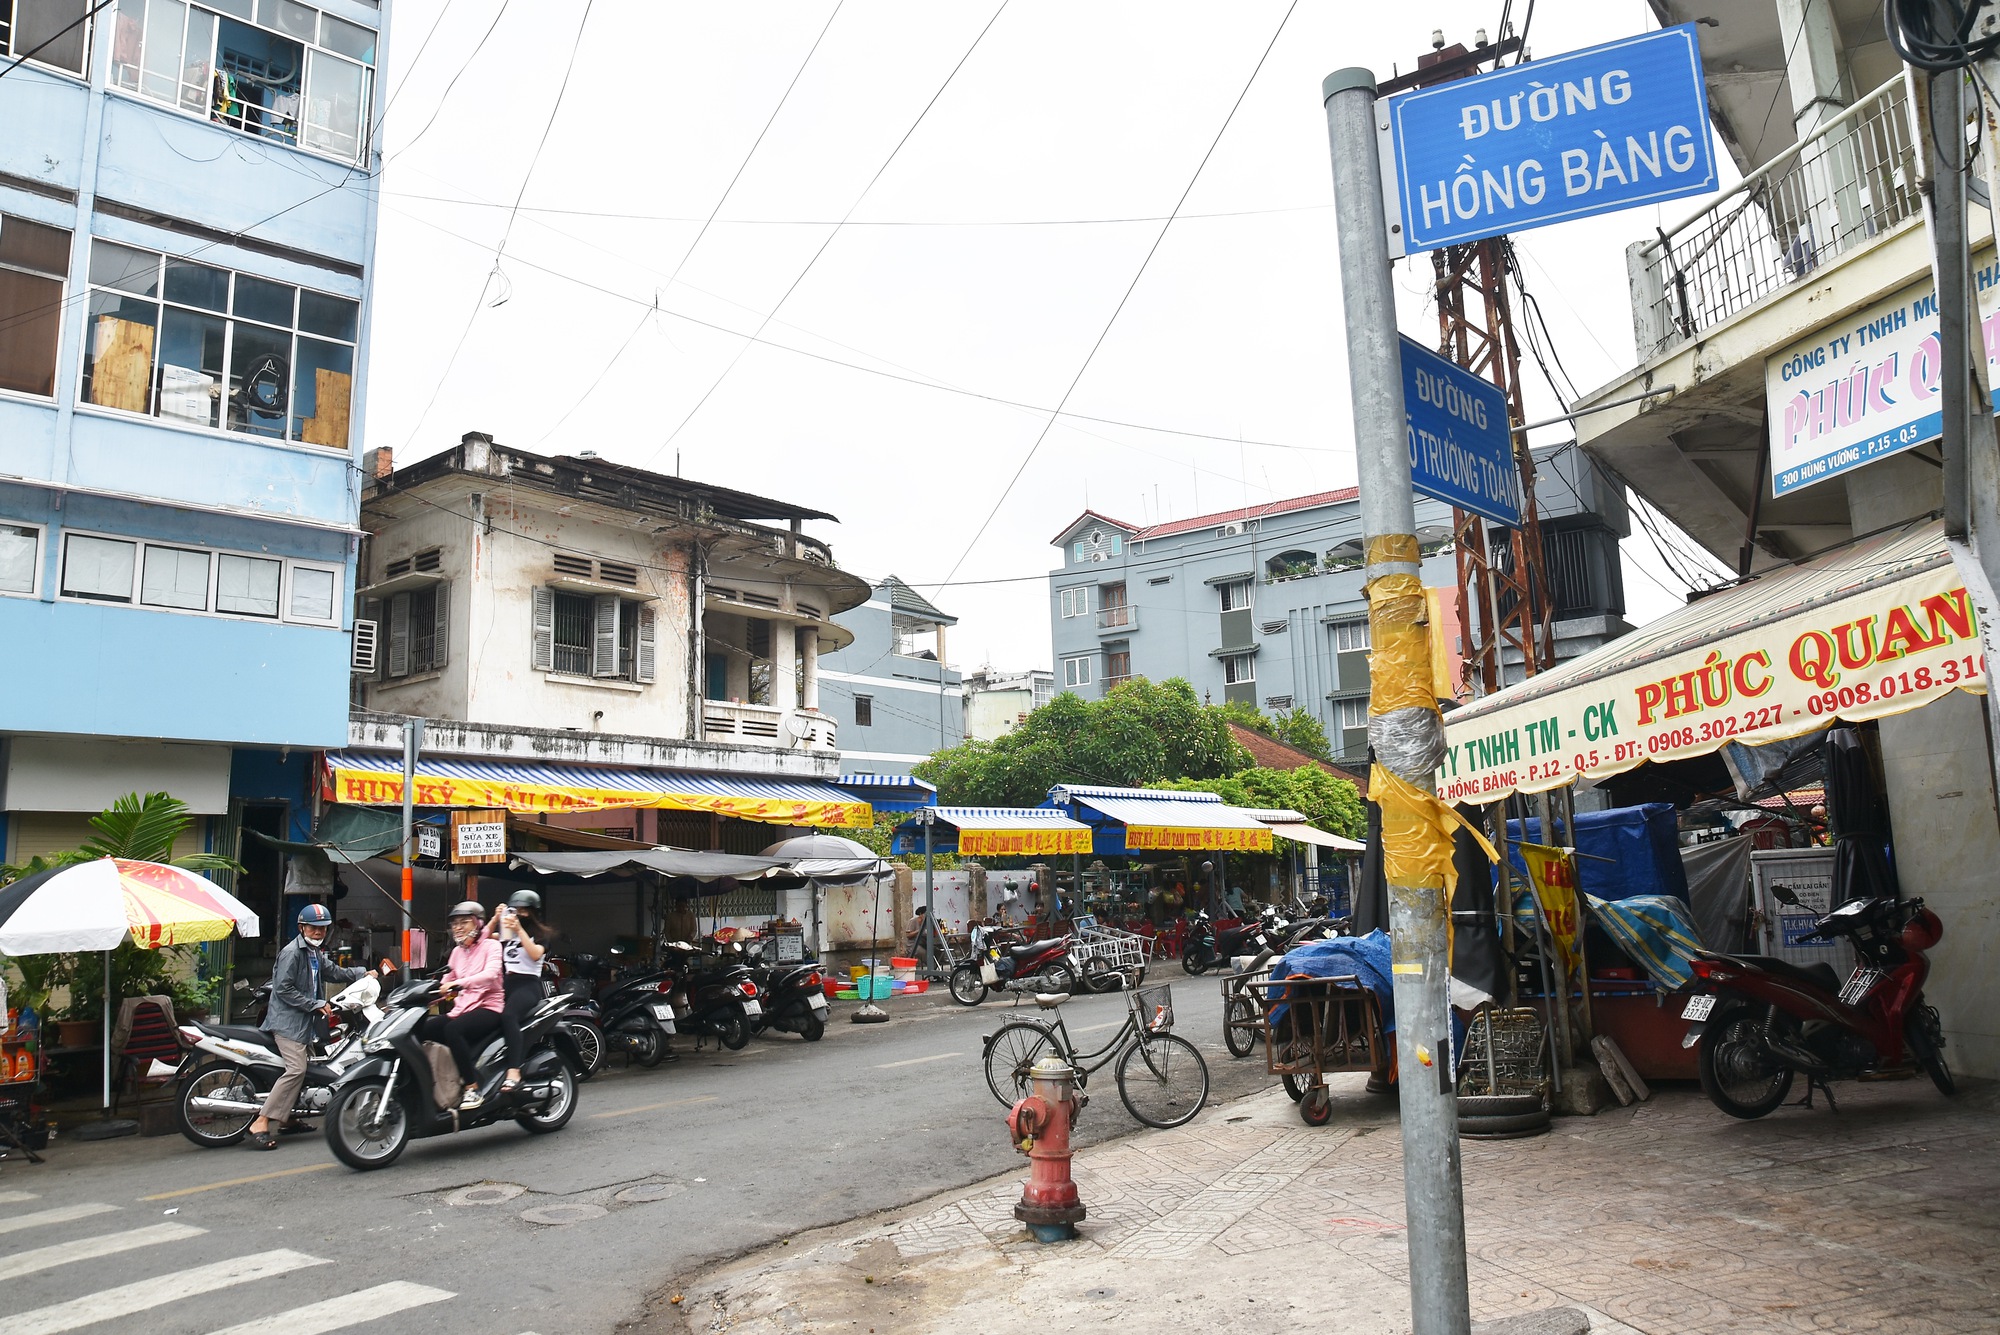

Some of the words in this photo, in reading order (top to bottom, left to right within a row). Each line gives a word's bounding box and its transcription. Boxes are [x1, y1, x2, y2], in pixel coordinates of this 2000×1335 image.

[1458, 69, 1632, 141] ĐƯỜNG
[1419, 154, 1546, 230] HỒNG
[1561, 125, 1696, 198] BÀNG
[1781, 346, 1826, 383] CÔNG
[1829, 333, 1852, 361] TY
[1856, 307, 1908, 347] TNHH
[1415, 367, 1488, 430] ĐƯỜNG
[1784, 352, 1899, 452] PHÚC
[1418, 427, 1480, 495] TRƯỜNG
[1479, 448, 1518, 511] TOẢN
[1782, 470, 1799, 488] 300
[1801, 457, 1826, 482] HÙNG
[1828, 447, 1860, 470] VƯƠNG
[1868, 435, 1891, 457] P.15
[1900, 424, 1918, 444] Q.5
[1464, 727, 1519, 773] TNHH
[1525, 715, 1561, 758] TM
[1583, 698, 1619, 743] CK
[1634, 648, 1775, 727] PHÚC
[344, 777, 404, 804] HUY
[416, 780, 457, 805] KÝ
[1447, 776, 1480, 800] HỒNG
[1482, 768, 1518, 793] BÀNG
[1529, 759, 1561, 782] P.12
[1574, 750, 1599, 773] Q.5
[1614, 740, 1643, 763] ĐT:
[1647, 703, 1784, 755] 0908.302.227
